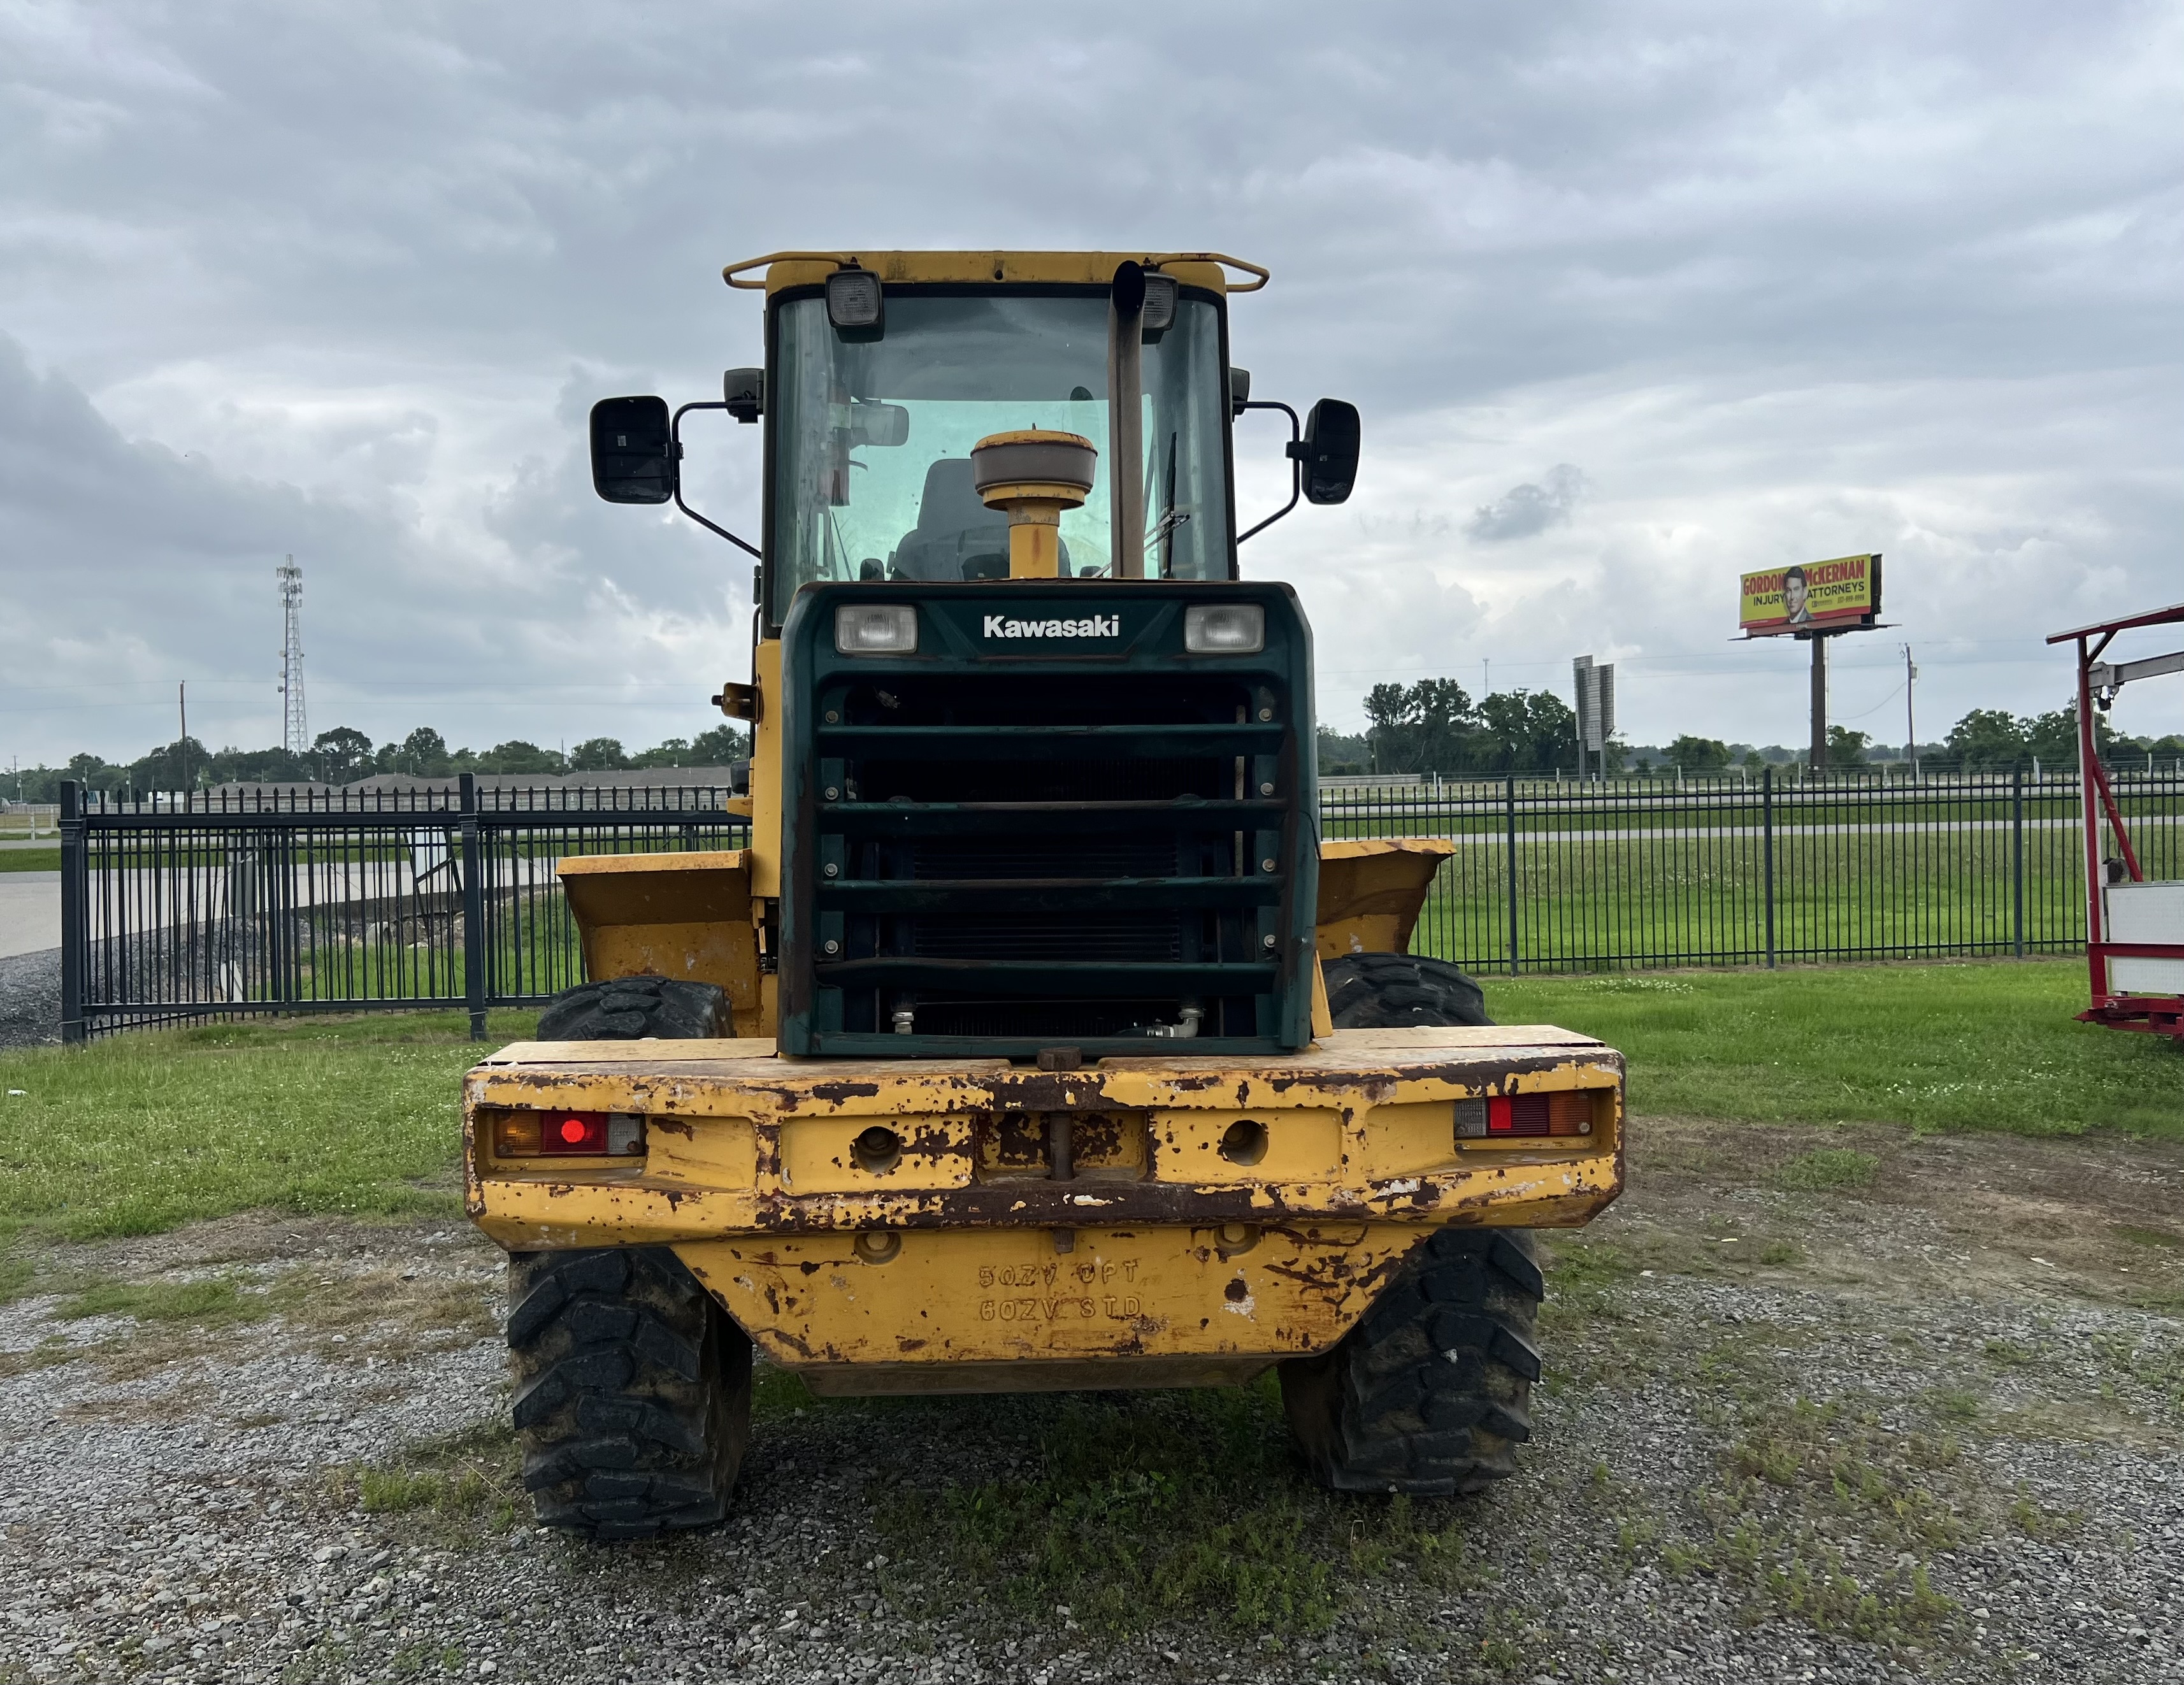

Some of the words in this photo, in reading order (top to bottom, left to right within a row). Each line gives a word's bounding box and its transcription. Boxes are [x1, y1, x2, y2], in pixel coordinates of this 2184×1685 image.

[1743, 573, 1785, 596] GORDON
[1804, 560, 1864, 586] McKERNAN
[1753, 594, 1785, 606] INJURY
[1807, 582, 1864, 599] ATTORNEYS
[984, 615, 1119, 638] Kawasaki
[1078, 1259, 1138, 1284] OPT
[980, 1299, 1057, 1321] 60ZV
[1080, 1296, 1140, 1317] STD
